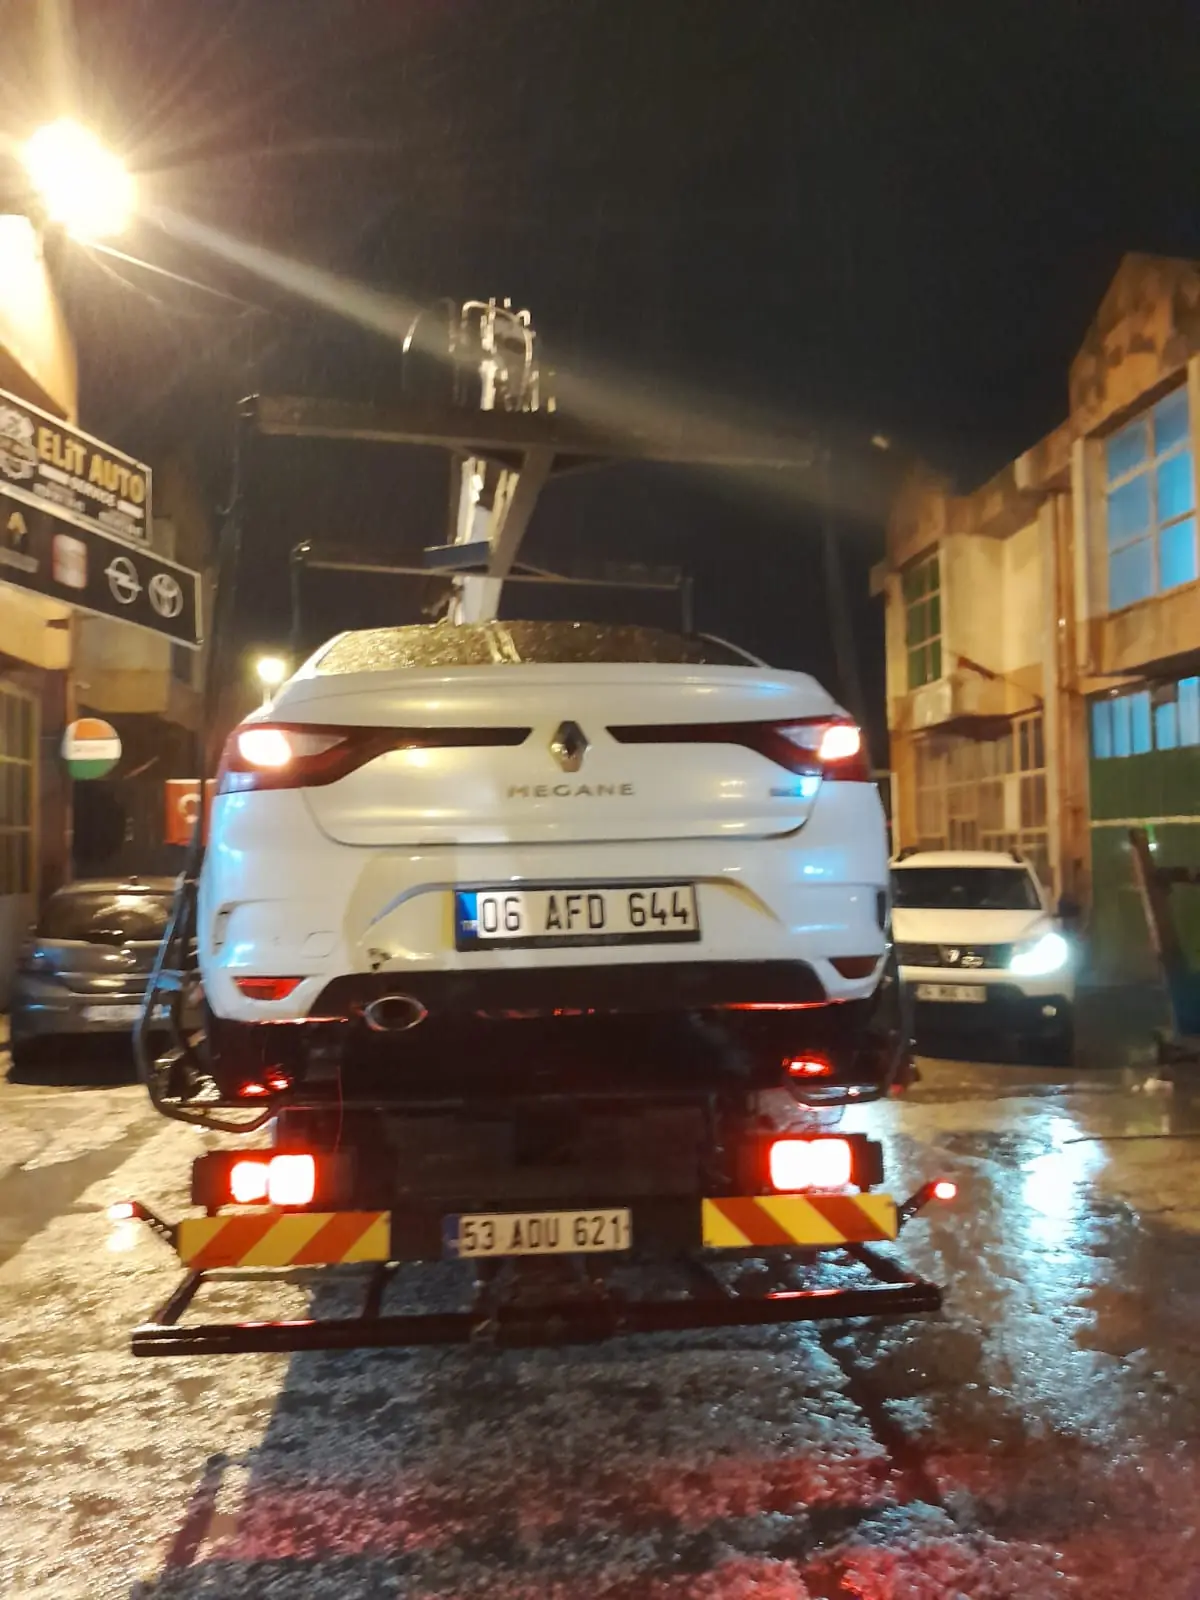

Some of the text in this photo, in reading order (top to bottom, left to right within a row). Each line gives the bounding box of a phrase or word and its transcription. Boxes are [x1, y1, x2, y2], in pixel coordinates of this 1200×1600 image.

[89, 454, 146, 503] AUTO
[507, 782, 635, 799] MEGANE
[481, 890, 690, 933] 06 AFD 644
[462, 1220, 496, 1251] 53
[573, 1214, 622, 1247] 621
